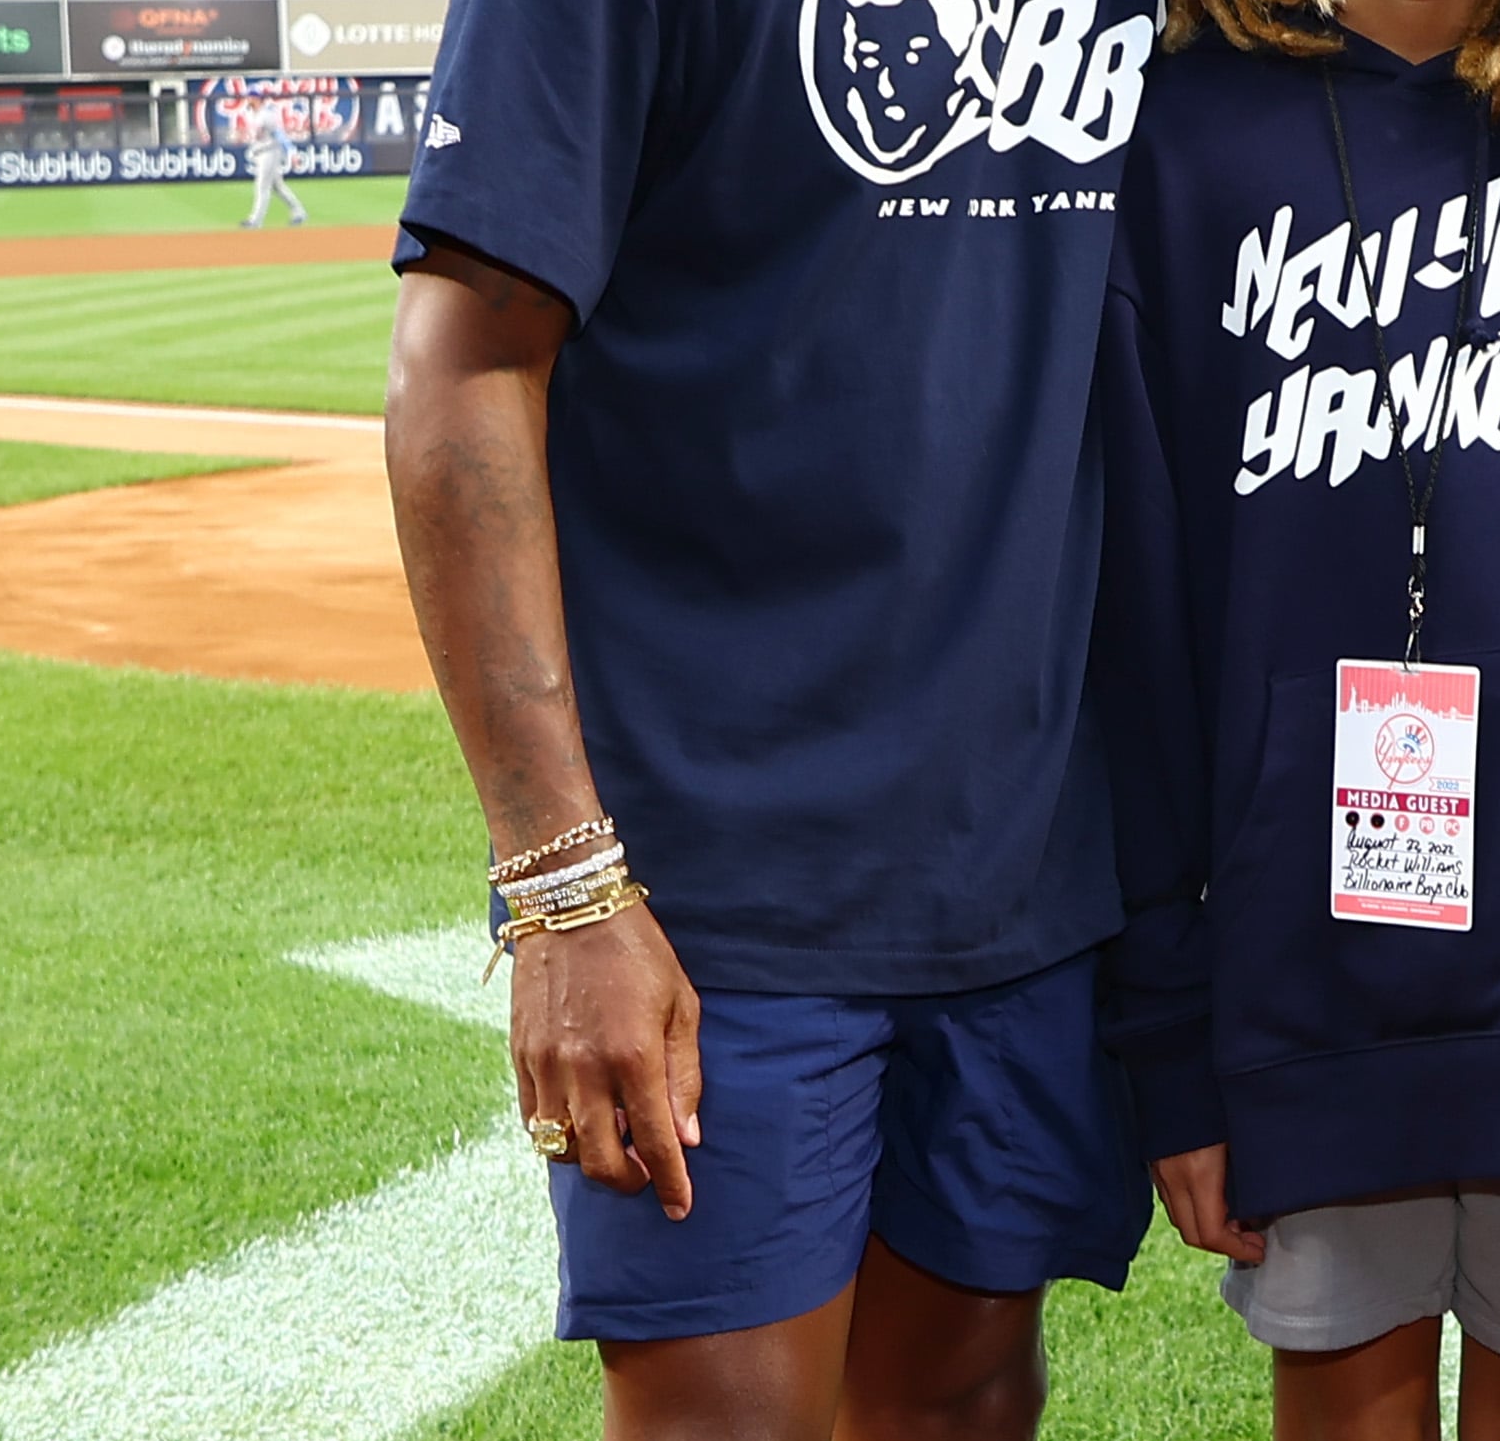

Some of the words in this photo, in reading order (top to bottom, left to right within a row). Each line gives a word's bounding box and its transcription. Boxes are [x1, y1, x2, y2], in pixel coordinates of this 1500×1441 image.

[336, 22, 410, 44] LOTTE
[119, 147, 237, 180] StubHub
[878, 197, 950, 218] NEW
[1221, 204, 1419, 360] NEW
[1346, 790, 1400, 810] MEDIA
[1405, 794, 1460, 815] GUEST
